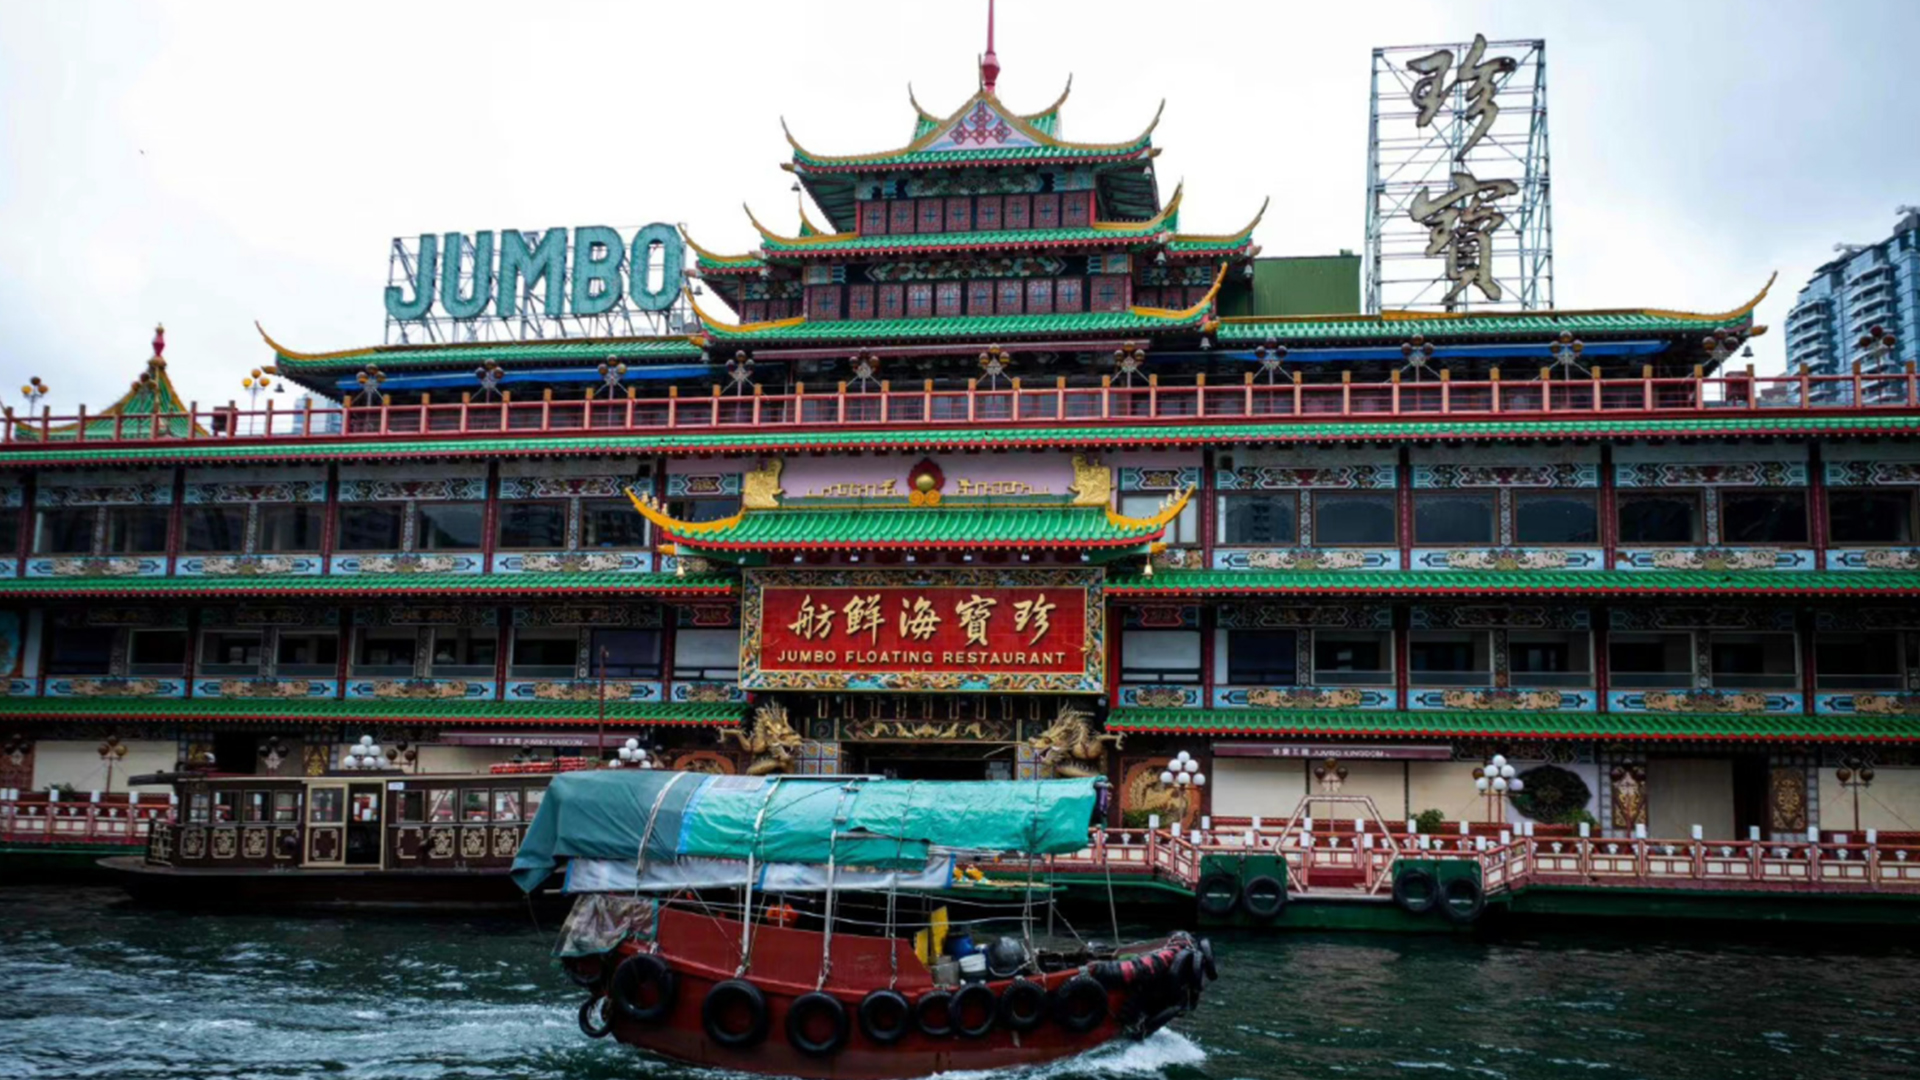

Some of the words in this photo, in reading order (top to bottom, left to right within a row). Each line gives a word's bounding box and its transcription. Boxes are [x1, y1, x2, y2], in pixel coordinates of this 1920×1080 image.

[1406, 33, 1519, 305] 珍寶
[384, 222, 684, 321] JUMBO
[777, 650, 836, 664] JUMBO
[845, 650, 933, 665] FLOATING
[942, 651, 1065, 666] RESTAURANT
